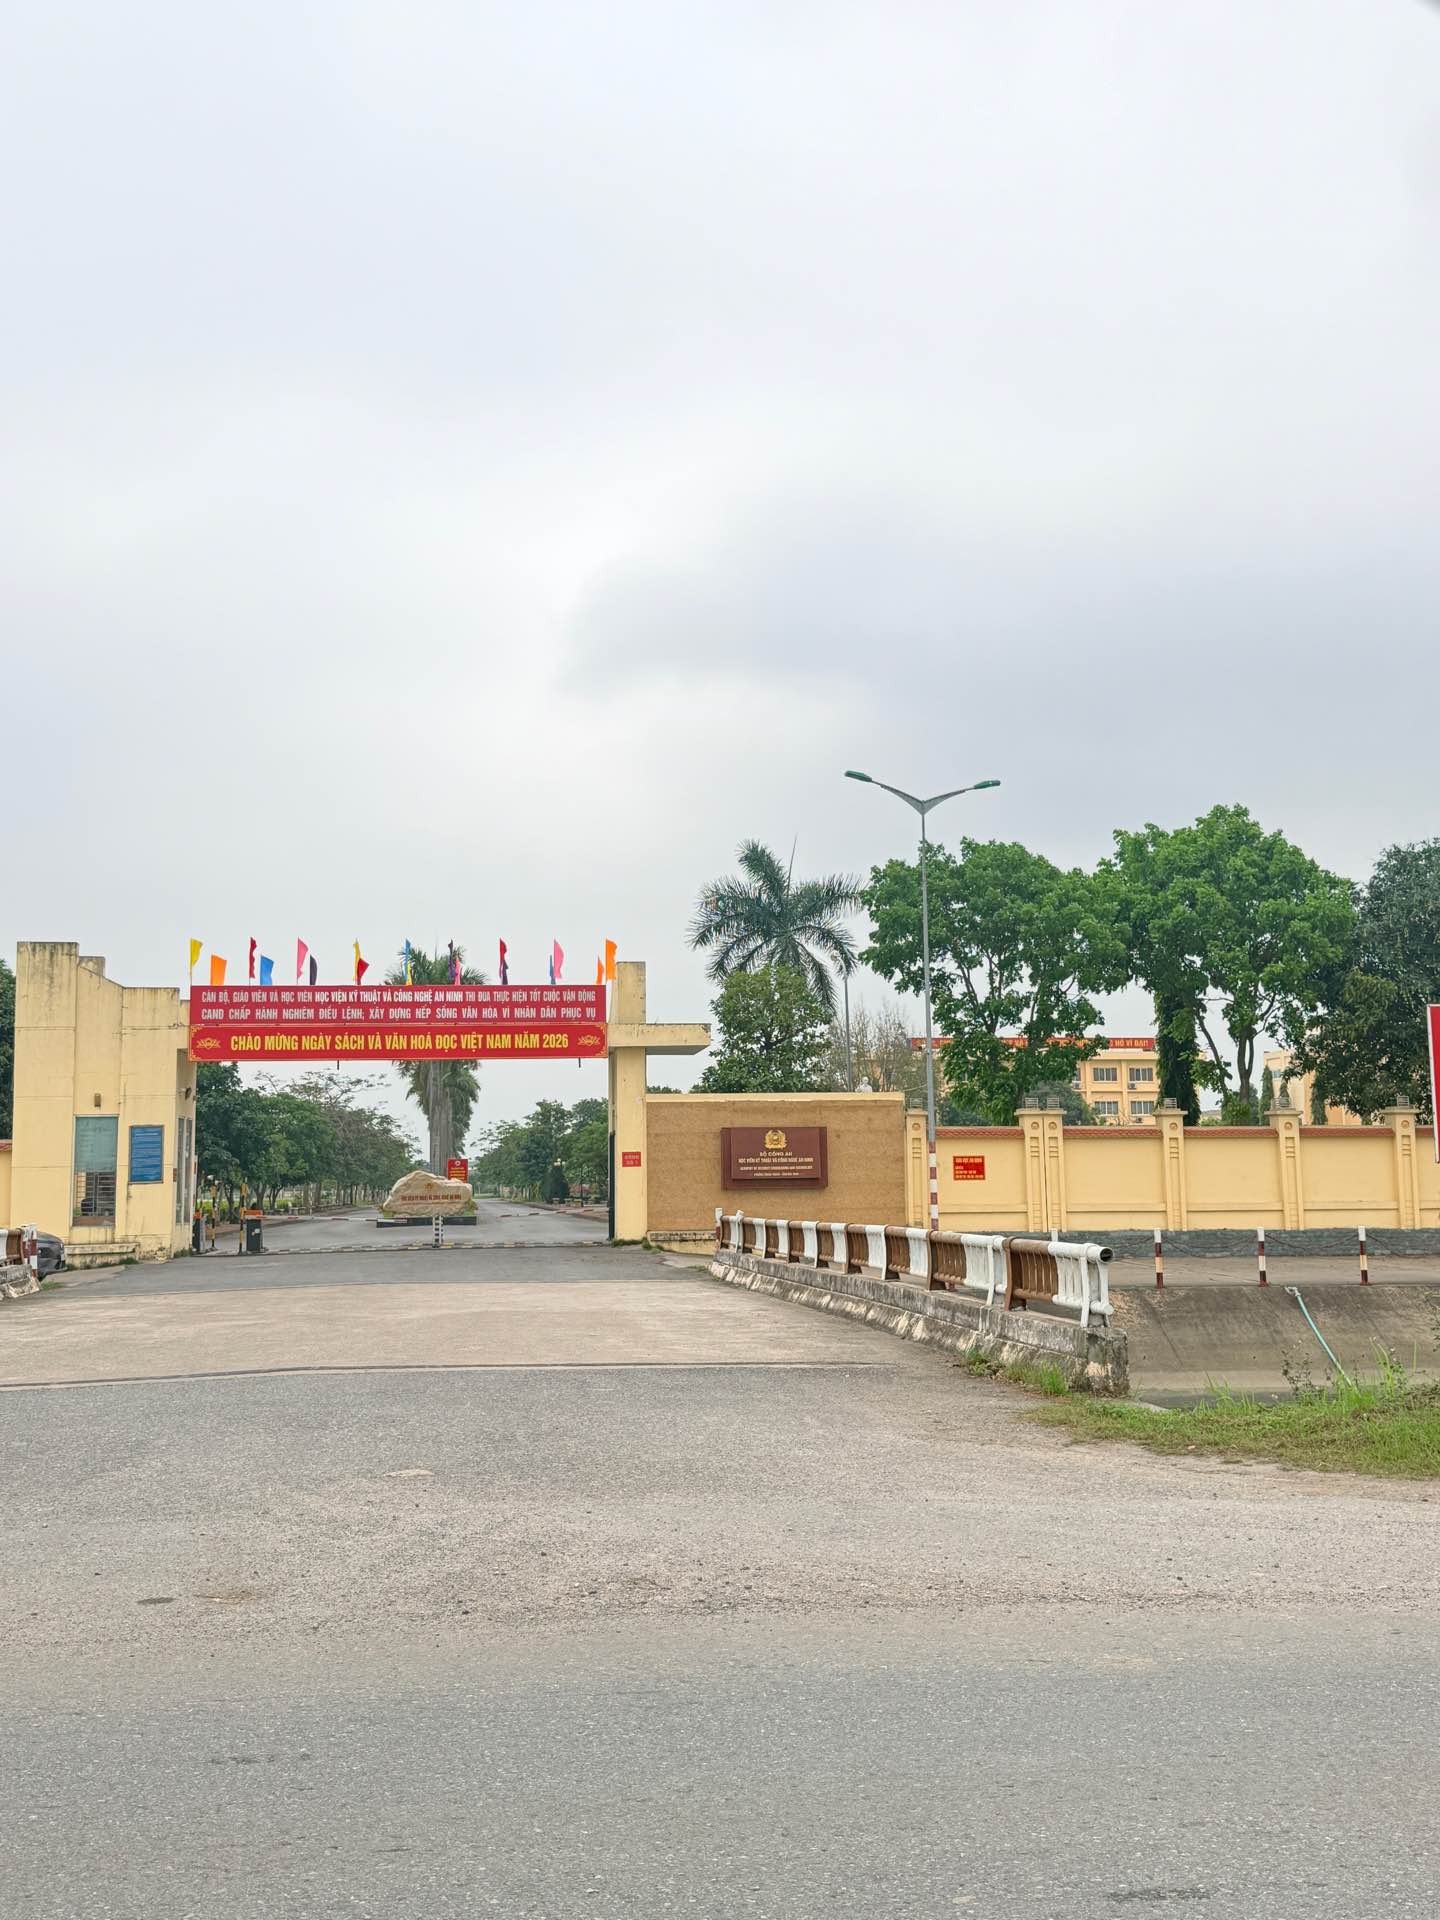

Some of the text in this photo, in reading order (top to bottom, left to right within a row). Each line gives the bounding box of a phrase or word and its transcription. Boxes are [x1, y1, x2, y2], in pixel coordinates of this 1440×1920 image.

[202, 989, 216, 1002] CÁN
[233, 989, 249, 1002] GIÁO
[251, 989, 267, 1002] VIÊN
[270, 989, 278, 1002] VÀ
[281, 991, 295, 1004] HỌC
[315, 991, 330, 1004] HỌC
[331, 988, 347, 1004] VIỆN
[349, 989, 358, 1002] KỸ
[360, 988, 381, 1004] THUẬT
[383, 988, 392, 1002] VÀ
[394, 988, 412, 1002] CÔNG
[414, 988, 433, 1004] NGHỆ
[434, 991, 444, 1002] AN
[446, 991, 464, 1002] NINH
[465, 991, 476, 1002] THI
[478, 991, 491, 1002] ĐUA
[493, 990, 510, 1004] THỰC
[512, 988, 527, 1004] HIỆN
[530, 988, 540, 1002] TỐT
[543, 989, 560, 1003] CUỘC
[562, 989, 576, 1003] VẬN
[578, 989, 596, 1003] ĐỘNG
[201, 1008, 224, 1020] CAND
[229, 1005, 251, 1020] CHẤP
[255, 1006, 278, 1020] HÀNH
[282, 1006, 314, 1020] NGHIÊM
[369, 1006, 384, 1019] XÂY
[389, 1007, 411, 1020] DỰNG
[415, 1003, 432, 1019] NẾP
[436, 1003, 458, 1019] SỐNG
[462, 1005, 478, 1019] VĂN
[502, 1005, 510, 1018] VÌ
[514, 1005, 536, 1018] NHÂN
[540, 1005, 557, 1018] DÂN
[561, 1007, 582, 1020] PHỤC
[586, 1007, 596, 1020] VỤ
[230, 1030, 568, 1053] CHÀO MỪNG NGÀY SÁCH VÀ VĂN HOÁ ĐỌC VIỆT NAM NĂM 2026
